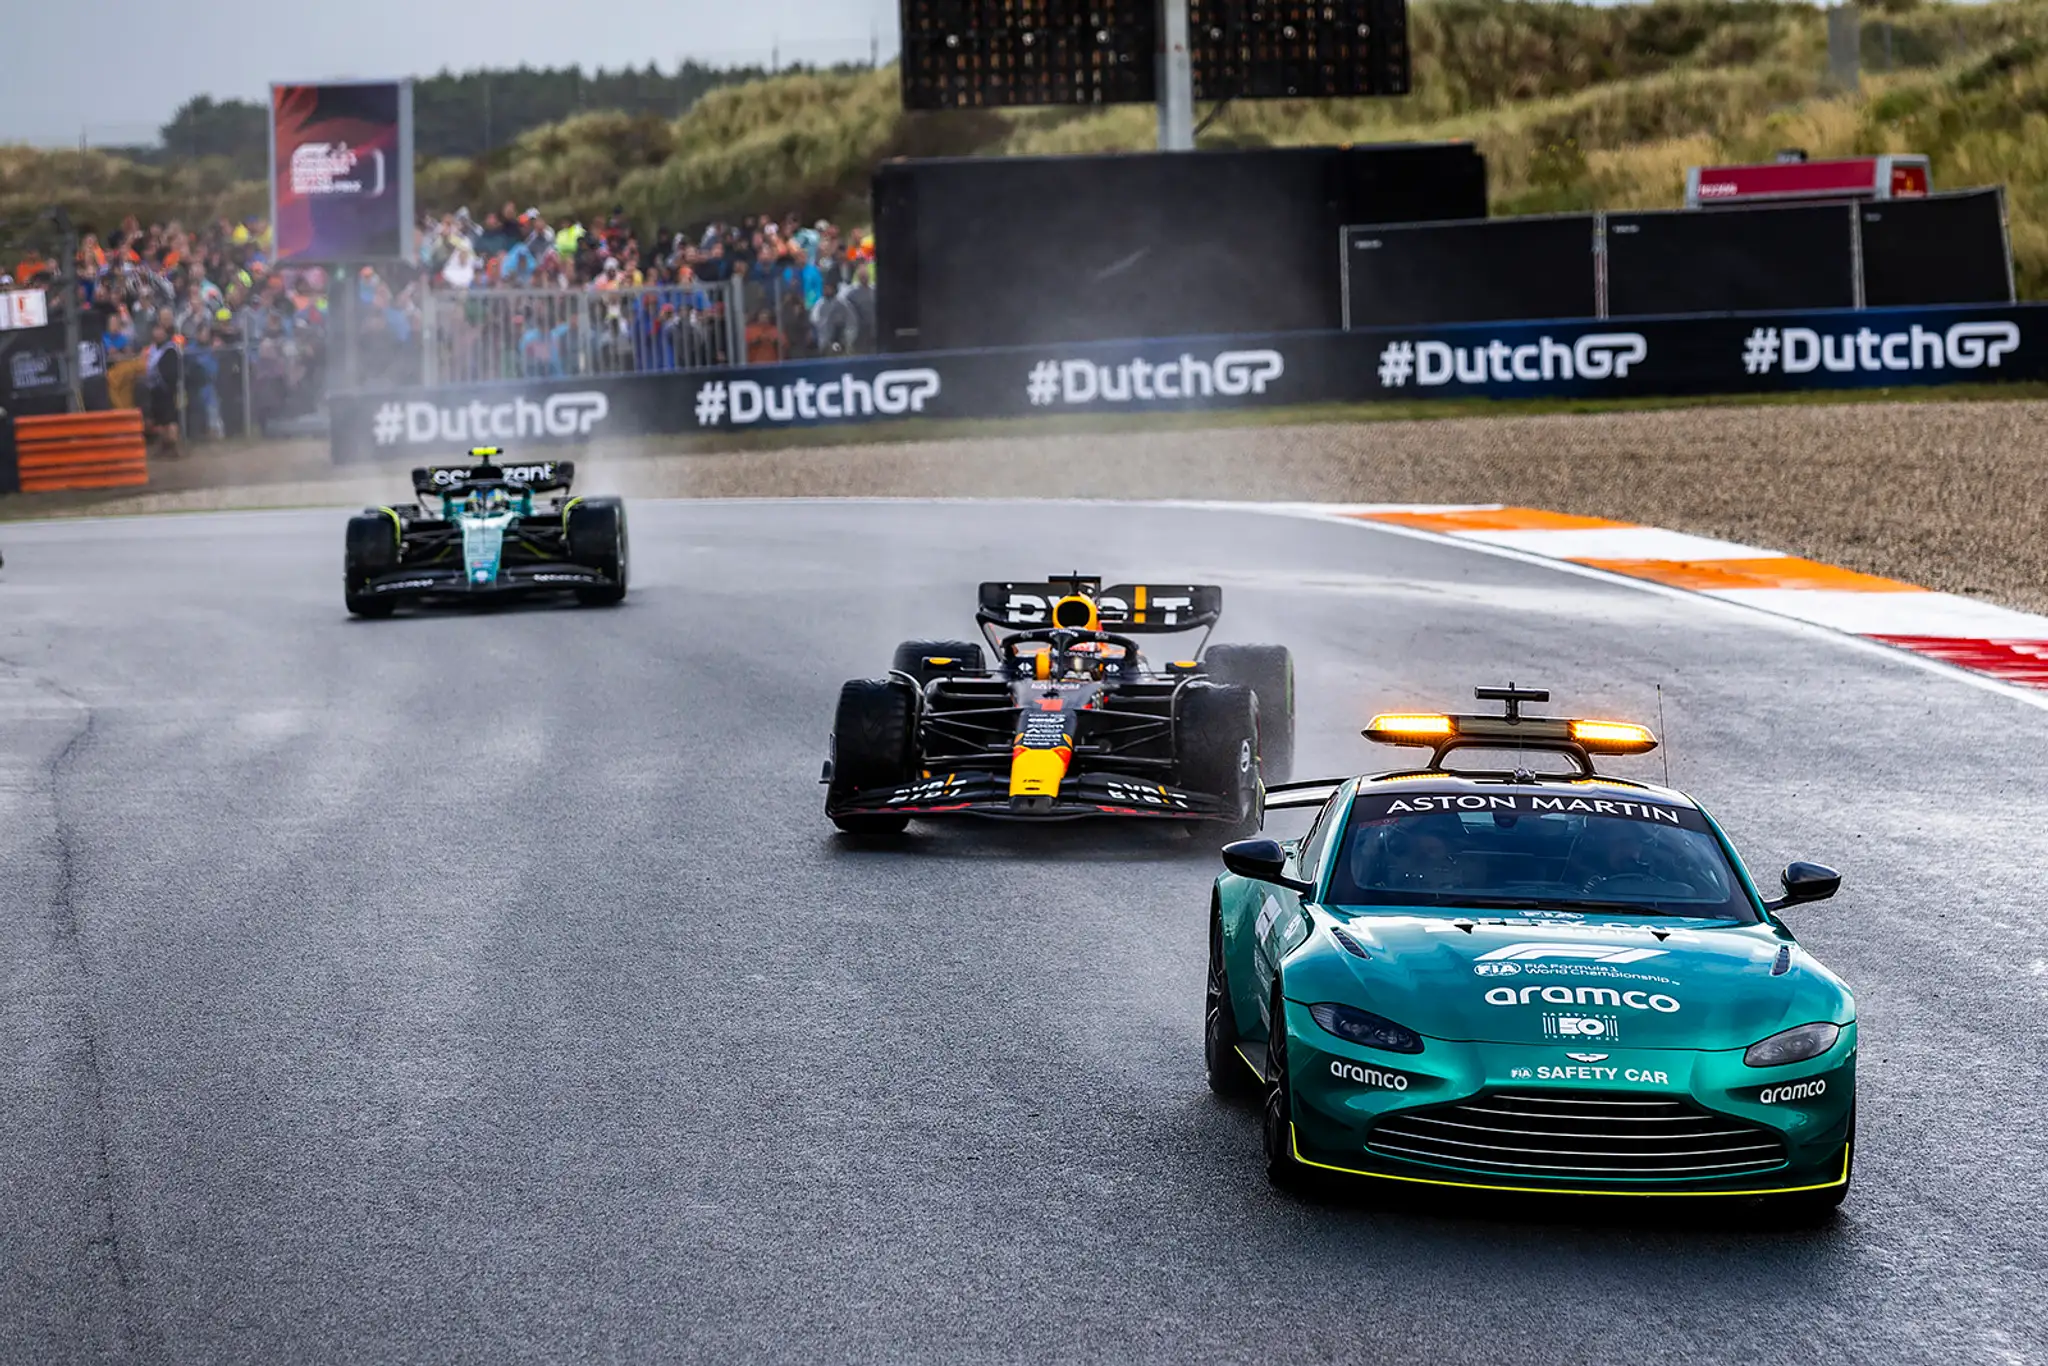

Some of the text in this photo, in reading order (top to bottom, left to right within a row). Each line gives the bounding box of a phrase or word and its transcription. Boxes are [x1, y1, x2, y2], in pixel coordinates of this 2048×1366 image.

[1378, 332, 1648, 389] #DutchGP
[1742, 320, 2020, 376] #DutchGP
[1026, 348, 1284, 407] #DutchGP
[695, 367, 941, 427] #DutchGP
[373, 391, 608, 445] #DutchGP
[1387, 795, 1680, 825] ASTON MARTIN
[1475, 962, 1519, 977] FIA
[1549, 963, 1609, 971] Formula
[1570, 968, 1670, 984] Championship
[1484, 985, 1681, 1013] aramco
[1558, 1017, 1605, 1036] 50
[1330, 1060, 1408, 1091] aramco
[1511, 1066, 1669, 1085] FIA SAFETY CAR
[1760, 1079, 1827, 1104] aramco
